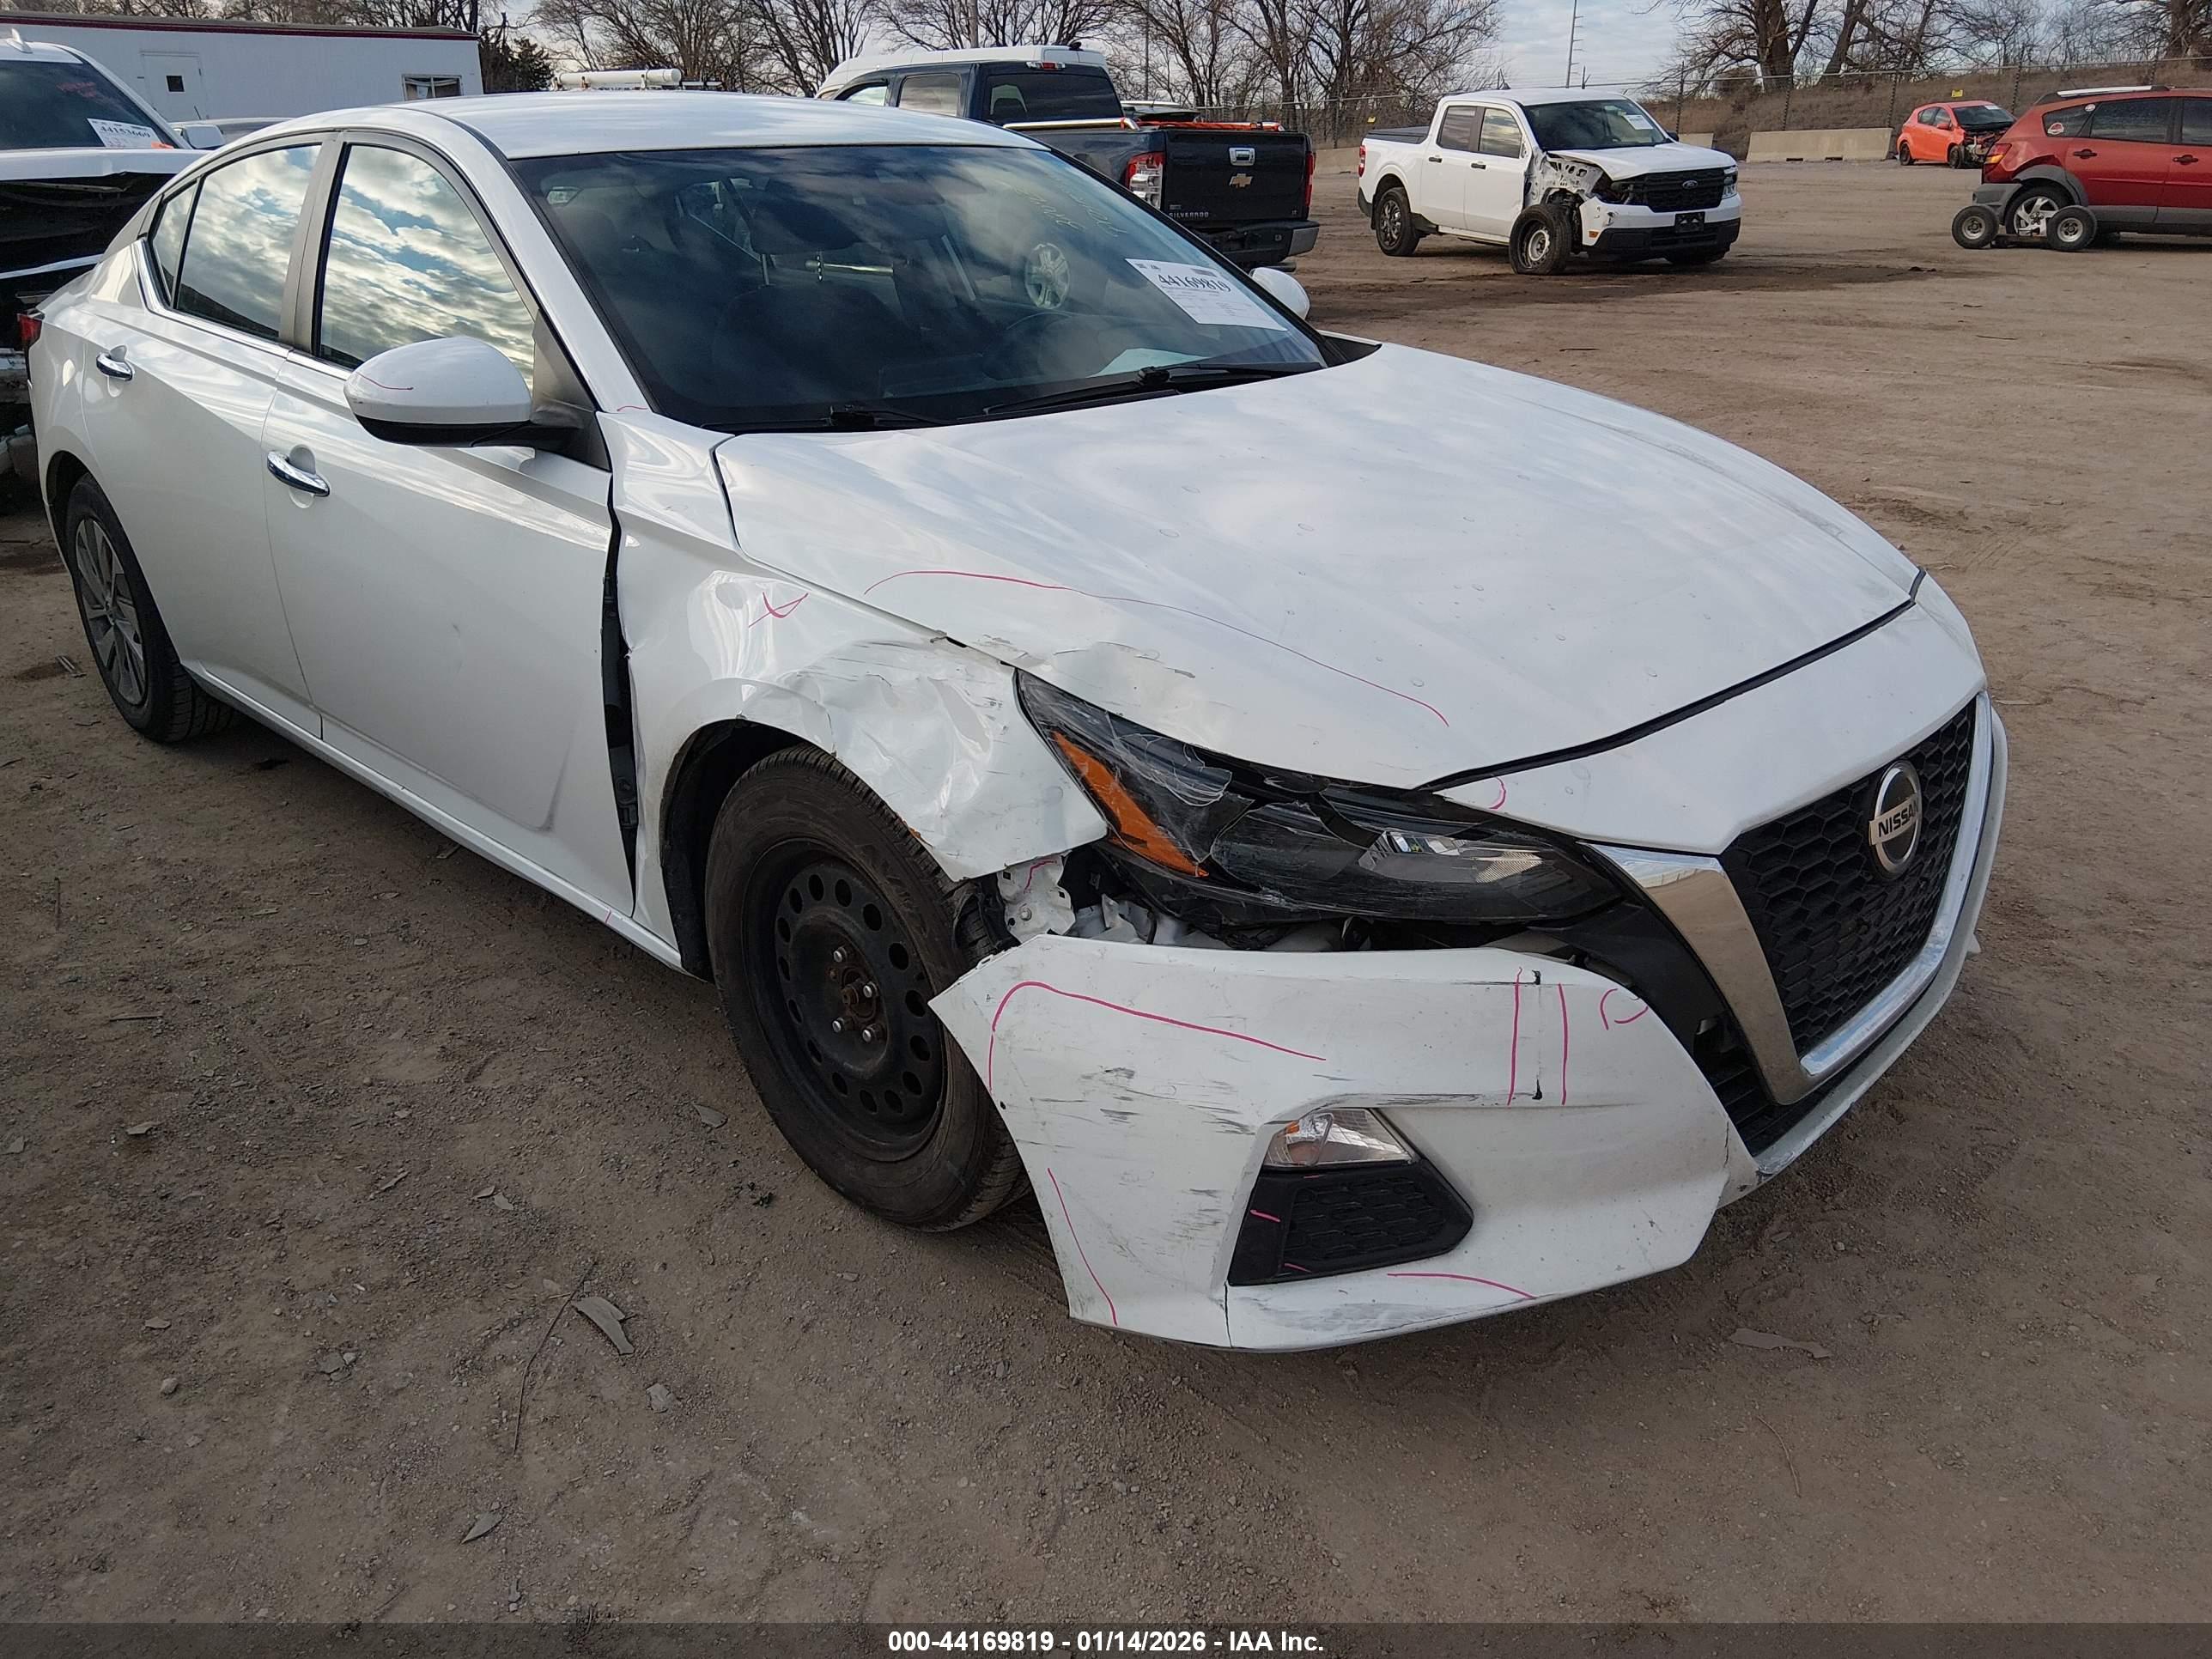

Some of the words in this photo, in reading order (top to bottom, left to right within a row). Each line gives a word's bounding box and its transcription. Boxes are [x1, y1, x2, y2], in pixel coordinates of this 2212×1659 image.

[1169, 211, 1209, 220] SILVERADO
[1158, 274, 1231, 292] 44169819
[1878, 799, 1919, 838] NISSAN
